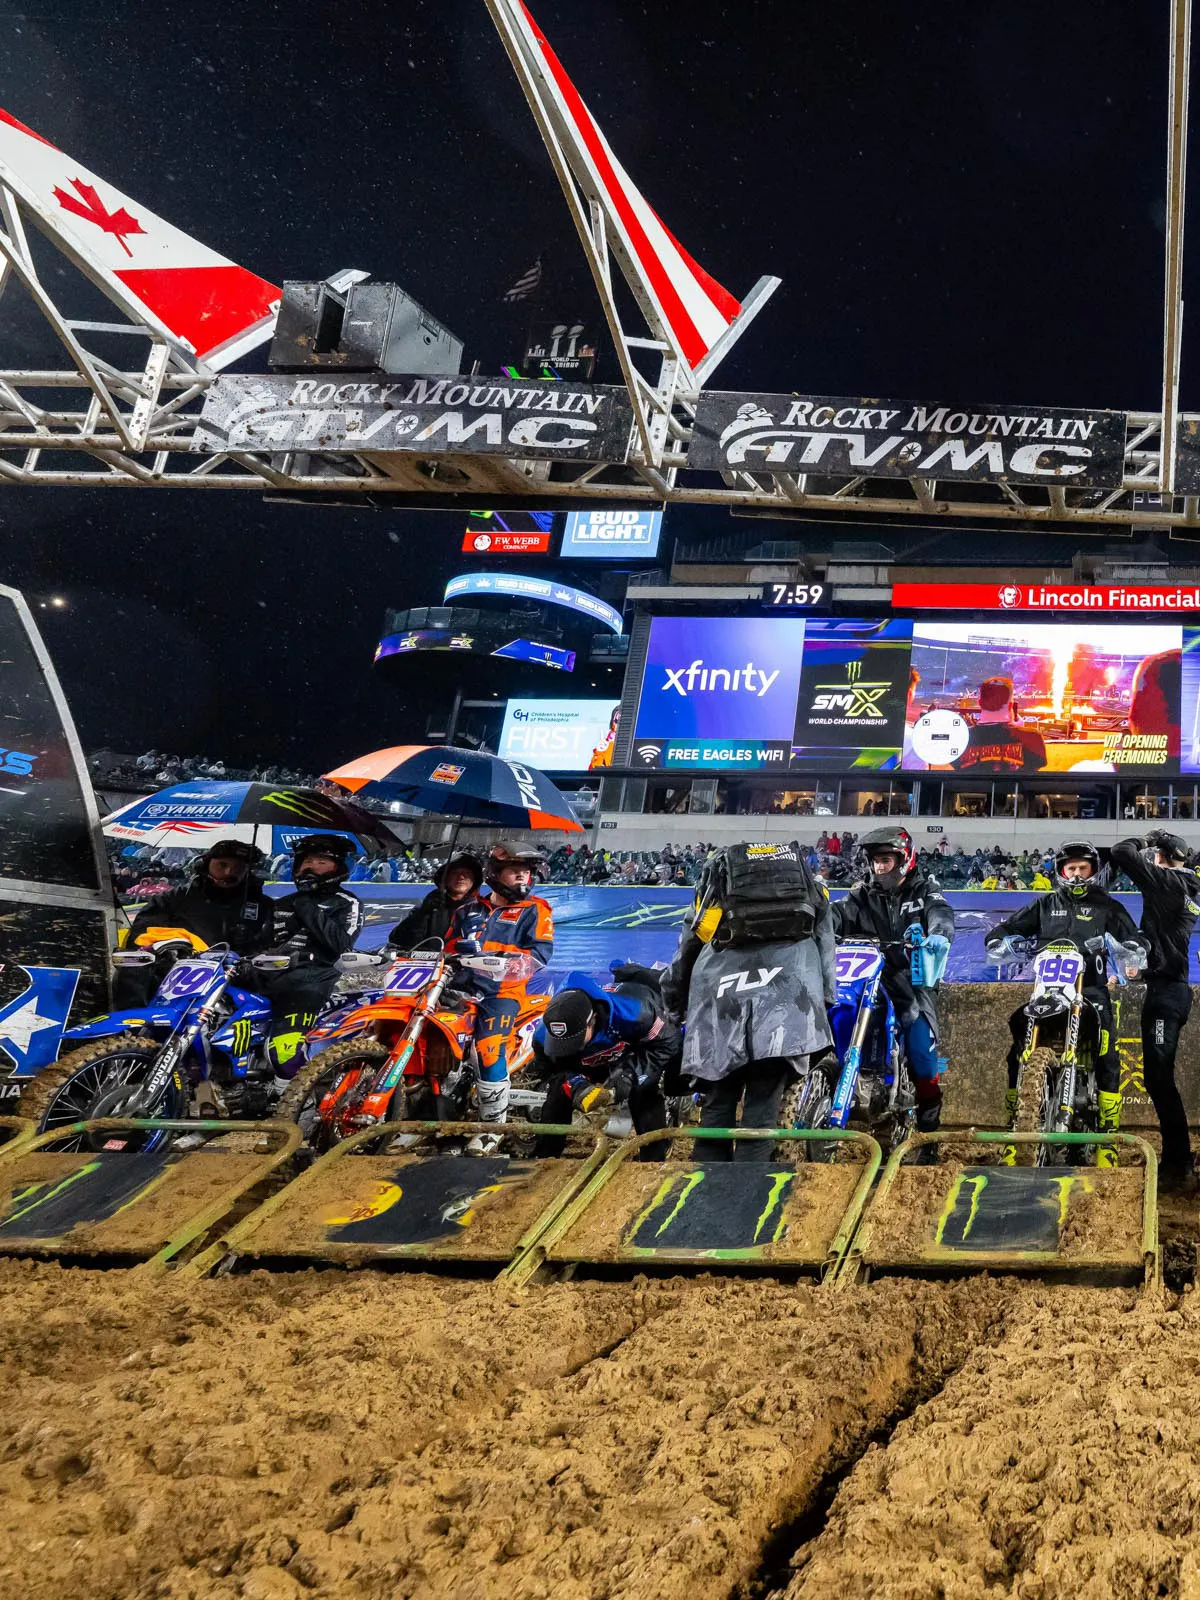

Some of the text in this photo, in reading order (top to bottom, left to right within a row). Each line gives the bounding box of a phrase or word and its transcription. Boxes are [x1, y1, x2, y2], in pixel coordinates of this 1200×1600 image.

[289, 379, 607, 416] ROCKY MOUNTAIN
[780, 401, 1098, 441] ROCKY MOUNTAIN
[588, 511, 640, 525] BUD
[512, 537, 540, 546] WEBB
[576, 524, 646, 541] LIGHT
[772, 584, 823, 605] 7:59
[1028, 588, 1103, 607] Lincoln
[1109, 589, 1200, 608] Financial
[661, 659, 781, 697] xfinity
[810, 687, 892, 717] SMX
[808, 717, 889, 727] WORLD CHAMPIONSHIP
[506, 726, 588, 750] FIRST
[1104, 734, 1168, 749] VIP OPENING
[667, 748, 784, 761] FREE EAGLES WIFI
[1101, 750, 1168, 765] CEREMONIES
[167, 804, 226, 815] YAMAHA
[160, 965, 215, 995] 99
[385, 967, 435, 990] 10
[1038, 958, 1080, 984] 199
[716, 966, 785, 999] FLY
